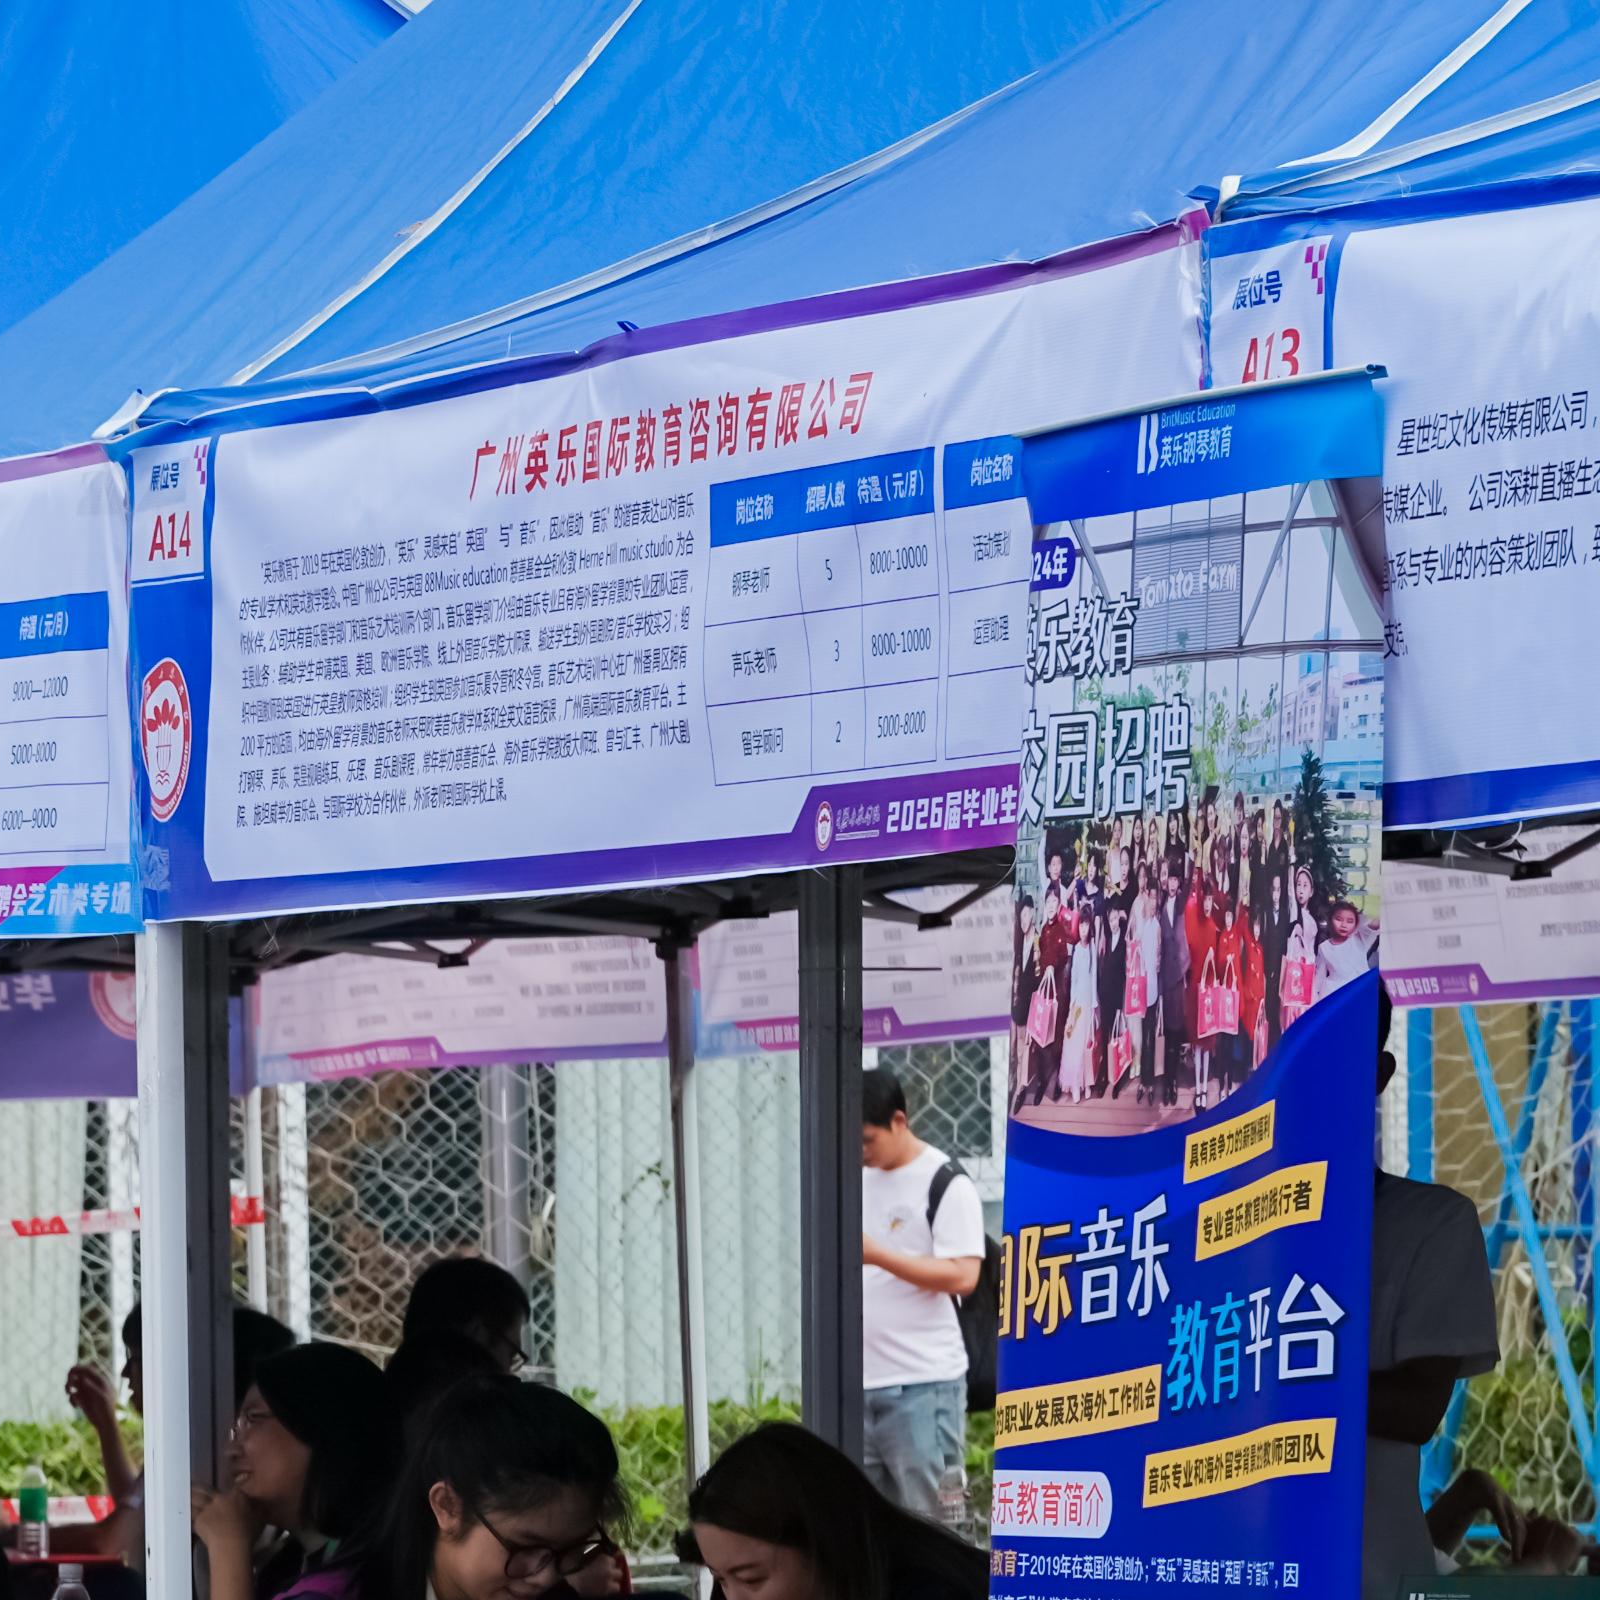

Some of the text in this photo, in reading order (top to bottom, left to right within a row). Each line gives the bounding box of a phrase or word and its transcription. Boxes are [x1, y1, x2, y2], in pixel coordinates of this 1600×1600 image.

[1232, 270, 1282, 310] 展位号
[1241, 328, 1300, 384] A13
[469, 371, 874, 502] 广州英乐国际教育咨询有限公司
[1197, 402, 1235, 422] Education
[1160, 424, 1232, 468] 英乐钢琴教育
[151, 462, 179, 491] 展位号
[736, 494, 774, 526] 岗位名称
[805, 483, 845, 514] 招聘人数
[970, 453, 1013, 486] 岗位名称
[149, 511, 191, 561] A14
[425, 567, 460, 595] 88Music
[462, 558, 508, 589] education
[578, 544, 603, 570] Herne
[619, 539, 643, 564] music
[645, 534, 674, 560] studio
[675, 531, 695, 557] 为合
[732, 530, 1012, 598] 钢琴老师 5 8000-10000 活动策划
[732, 614, 1010, 677] 声乐老师 3 8000-10000 运营助理
[10, 742, 57, 765] 5000-8000
[742, 710, 926, 757] 留学顾问 2 5000-8000
[886, 784, 1018, 833] 2026届毕业生
[1189, 1113, 1271, 1168] 具有竞争力的薪酬福利
[1203, 1180, 1312, 1245] 专业音乐教育的践行者
[1166, 1273, 1345, 1411] 教育平台
[1149, 1432, 1326, 1496] 音乐专业和海外留学背景的教师团队
